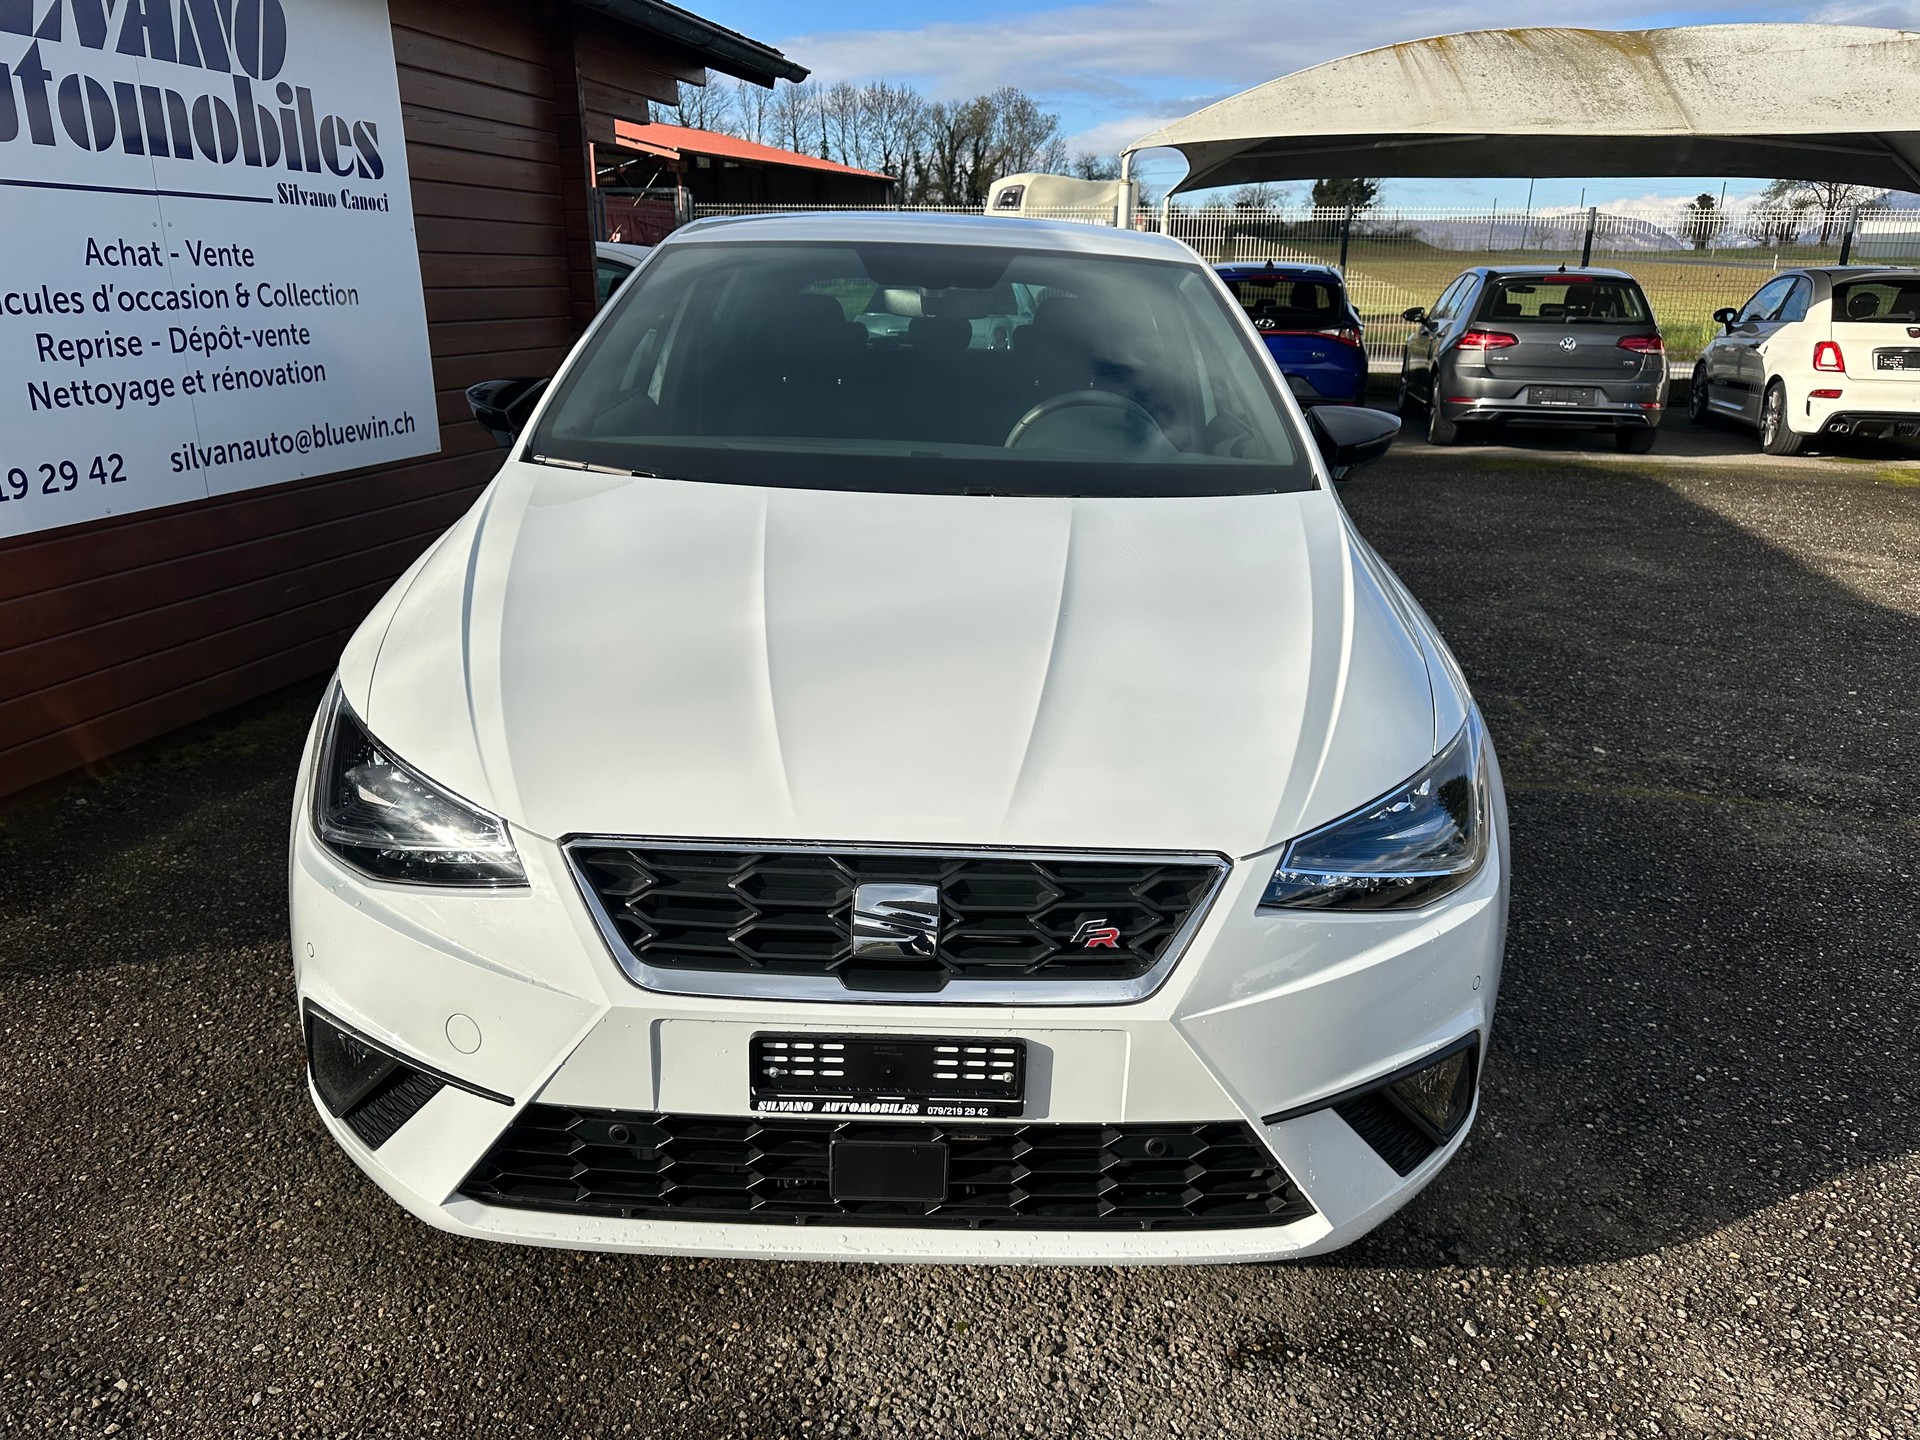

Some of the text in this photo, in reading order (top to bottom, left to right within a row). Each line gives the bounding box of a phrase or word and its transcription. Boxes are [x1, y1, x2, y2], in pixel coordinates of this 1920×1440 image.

[277, 182, 389, 212] Silvano Canoci
[85, 237, 163, 267] Achat
[185, 239, 255, 267] Vente
[0, 284, 85, 316] cules
[236, 283, 251, 308] &
[256, 282, 360, 307] Collection
[35, 331, 143, 367] Reprise
[169, 323, 311, 357] Dépôt-vente
[28, 361, 326, 411] Nettoyage et rénovation
[170, 411, 416, 473] silvanauto@bluewin.ch
[38, 460, 79, 495] 29
[88, 453, 127, 485] 42
[1070, 918, 1121, 949] FR
[757, 1100, 989, 1116] SILVANO AUTOMOBILES 079/219 29 42
